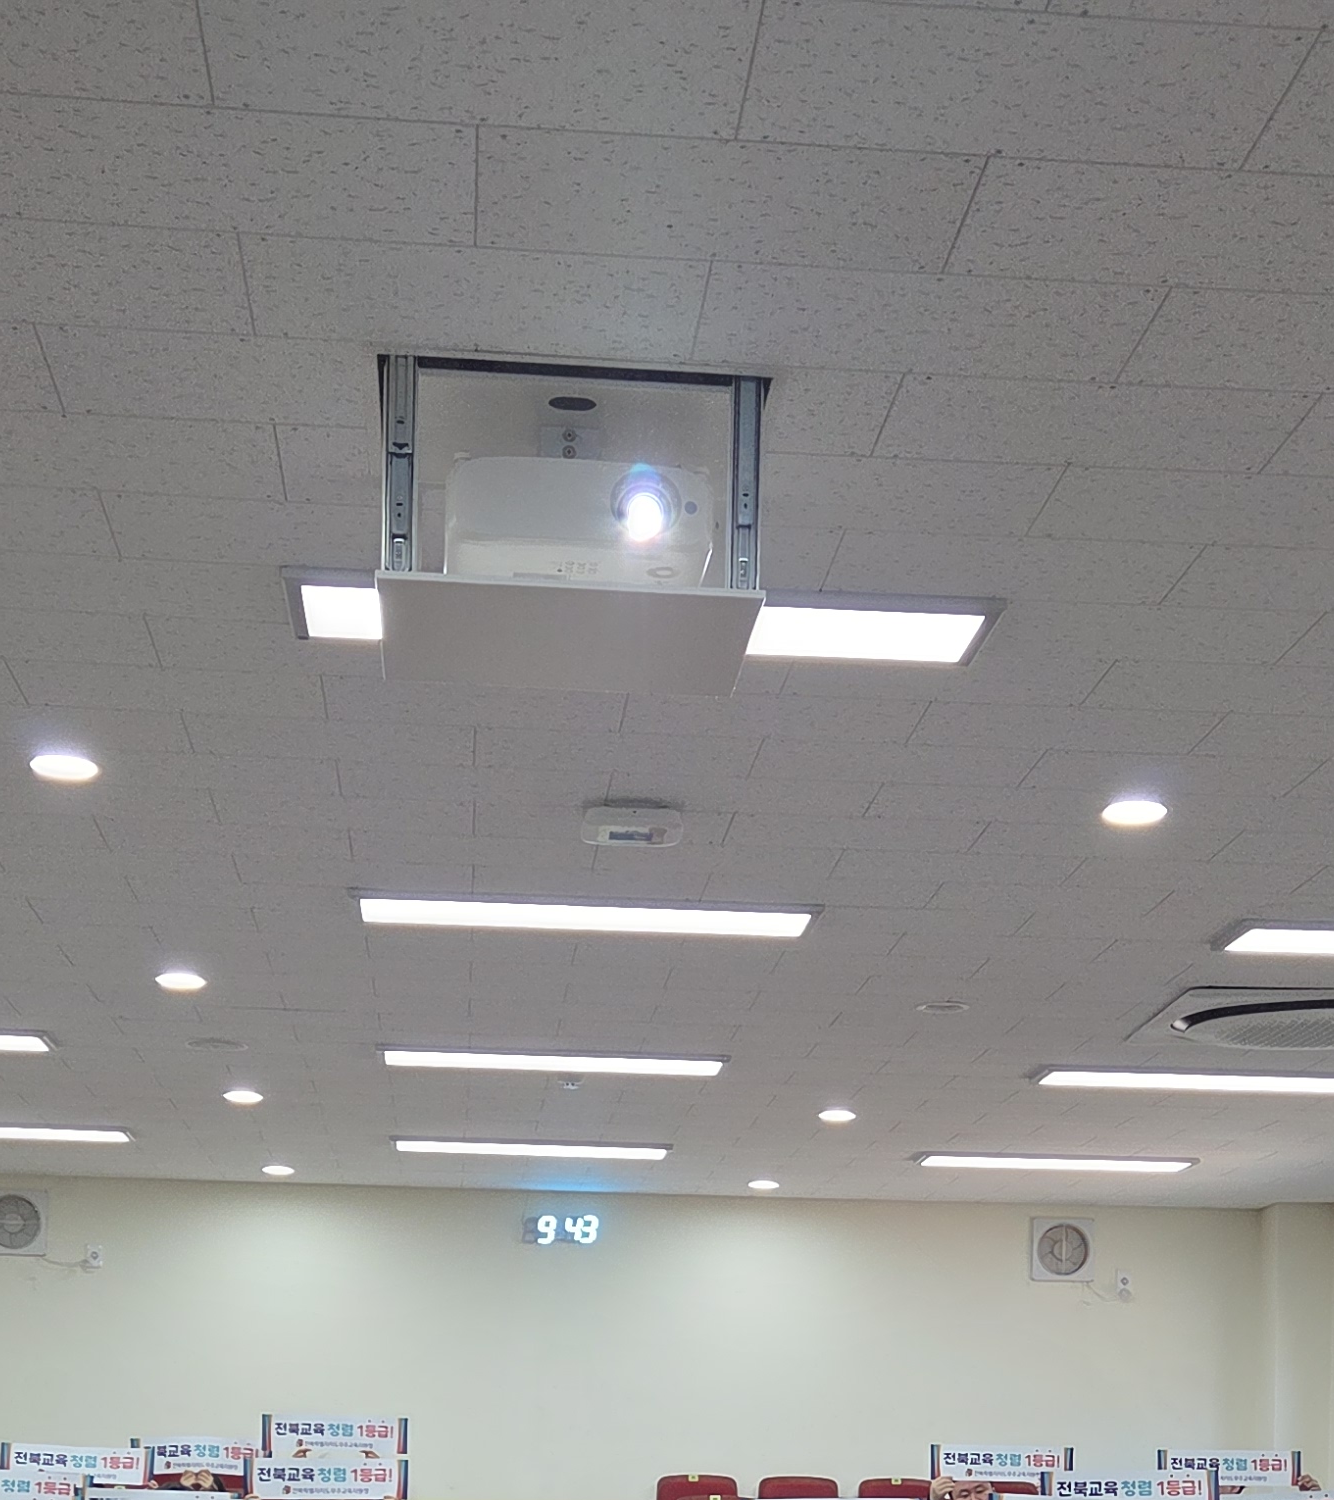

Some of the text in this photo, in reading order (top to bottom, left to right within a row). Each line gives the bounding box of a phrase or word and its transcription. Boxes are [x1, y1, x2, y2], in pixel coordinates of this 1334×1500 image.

[538, 1215, 599, 1244] 9 43
[275, 1420, 393, 1438] 전북교육 청렴 1등급!
[194, 1444, 219, 1457] 청렴
[944, 1450, 1059, 1468] 전북교육 청렴 1등급!
[15, 1452, 139, 1469] 전북교육 청렴 1등급!
[1171, 1454, 1287, 1471] 전북교육 청렴 1등급!
[258, 1463, 392, 1482] 전북교육 청렴 1등급!
[2, 1479, 30, 1493] 청렴
[1057, 1474, 1201, 1497] 전북교육 청렴 1등급!
